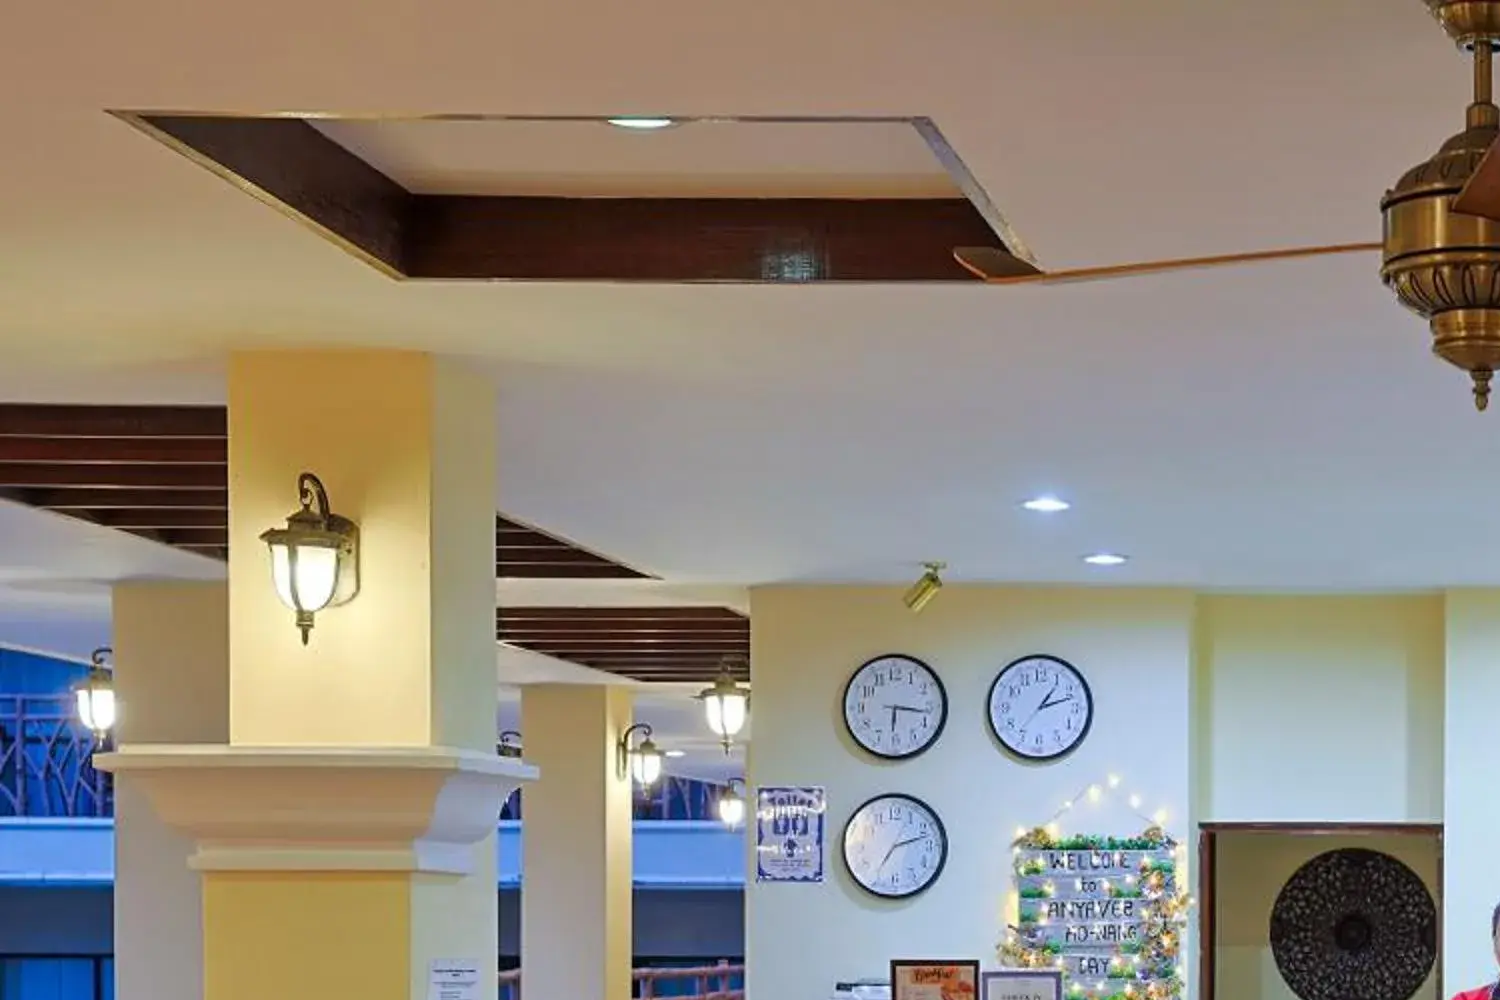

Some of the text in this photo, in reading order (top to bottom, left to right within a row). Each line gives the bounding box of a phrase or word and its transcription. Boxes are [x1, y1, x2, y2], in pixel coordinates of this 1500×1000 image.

[873, 672, 886, 686] 11
[887, 667, 902, 681] 12
[907, 671, 914, 685] 1
[1020, 672, 1031, 687] 11
[1034, 667, 1049, 683] 12
[1054, 673, 1060, 687] 1
[1064, 684, 1074, 698] 2
[1071, 702, 1080, 715] 3
[887, 805, 902, 821] 12
[907, 809, 914, 825] 1
[918, 822, 929, 839] 2
[924, 839, 934, 852] 3
[890, 872, 901, 883] 6
[1080, 878, 1097, 893] to
